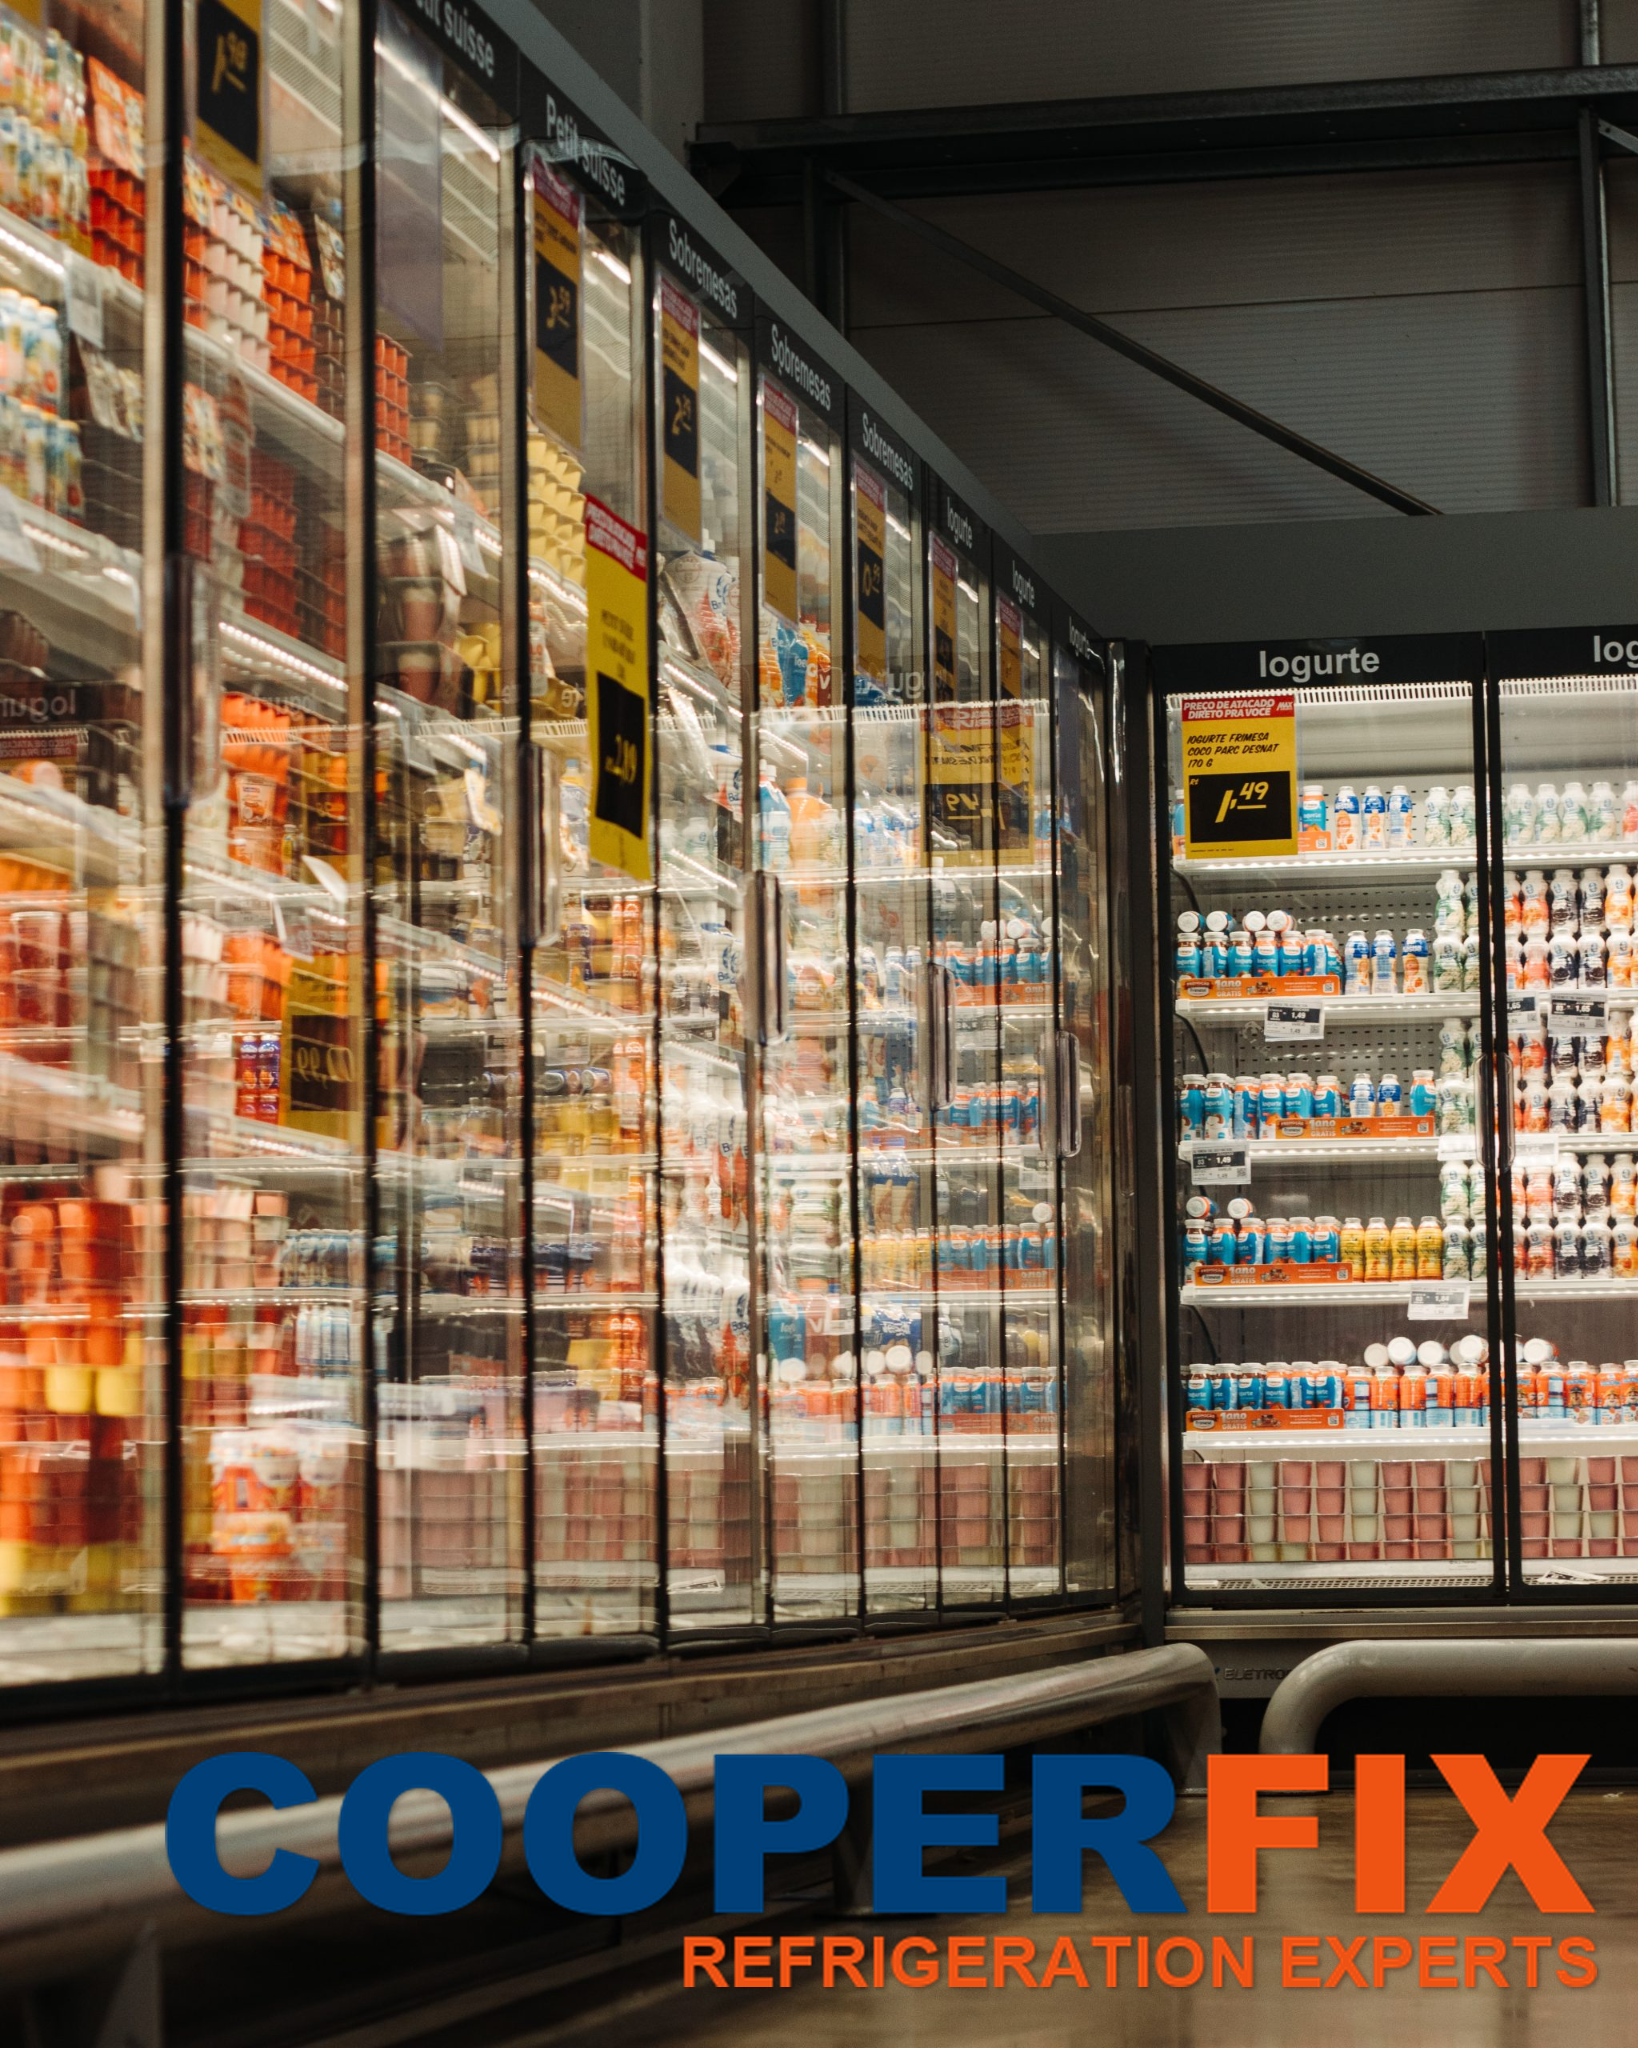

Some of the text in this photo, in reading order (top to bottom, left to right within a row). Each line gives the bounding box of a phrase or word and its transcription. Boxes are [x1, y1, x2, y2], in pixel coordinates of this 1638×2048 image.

[444, 1, 494, 78] suisse
[546, 93, 579, 164] Petit
[582, 140, 625, 207] suisse
[669, 218, 738, 319] Sobremesas
[771, 323, 831, 411] Sobremesas
[862, 412, 914, 492] Sobremesas
[947, 496, 973, 549] Iogurte
[1012, 559, 1035, 608] Iogurte
[1259, 646, 1380, 684] Iogurte
[1188, 709, 1224, 719] DIRETO
[1224, 708, 1245, 717] PRA
[1216, 700, 1229, 709] DE
[1230, 698, 1275, 708] ATACADO
[1187, 732, 1270, 744] IOGURTE FRIMESA
[1188, 743, 1279, 756] COCO PARC DESNAT
[1188, 759, 1204, 768] 170
